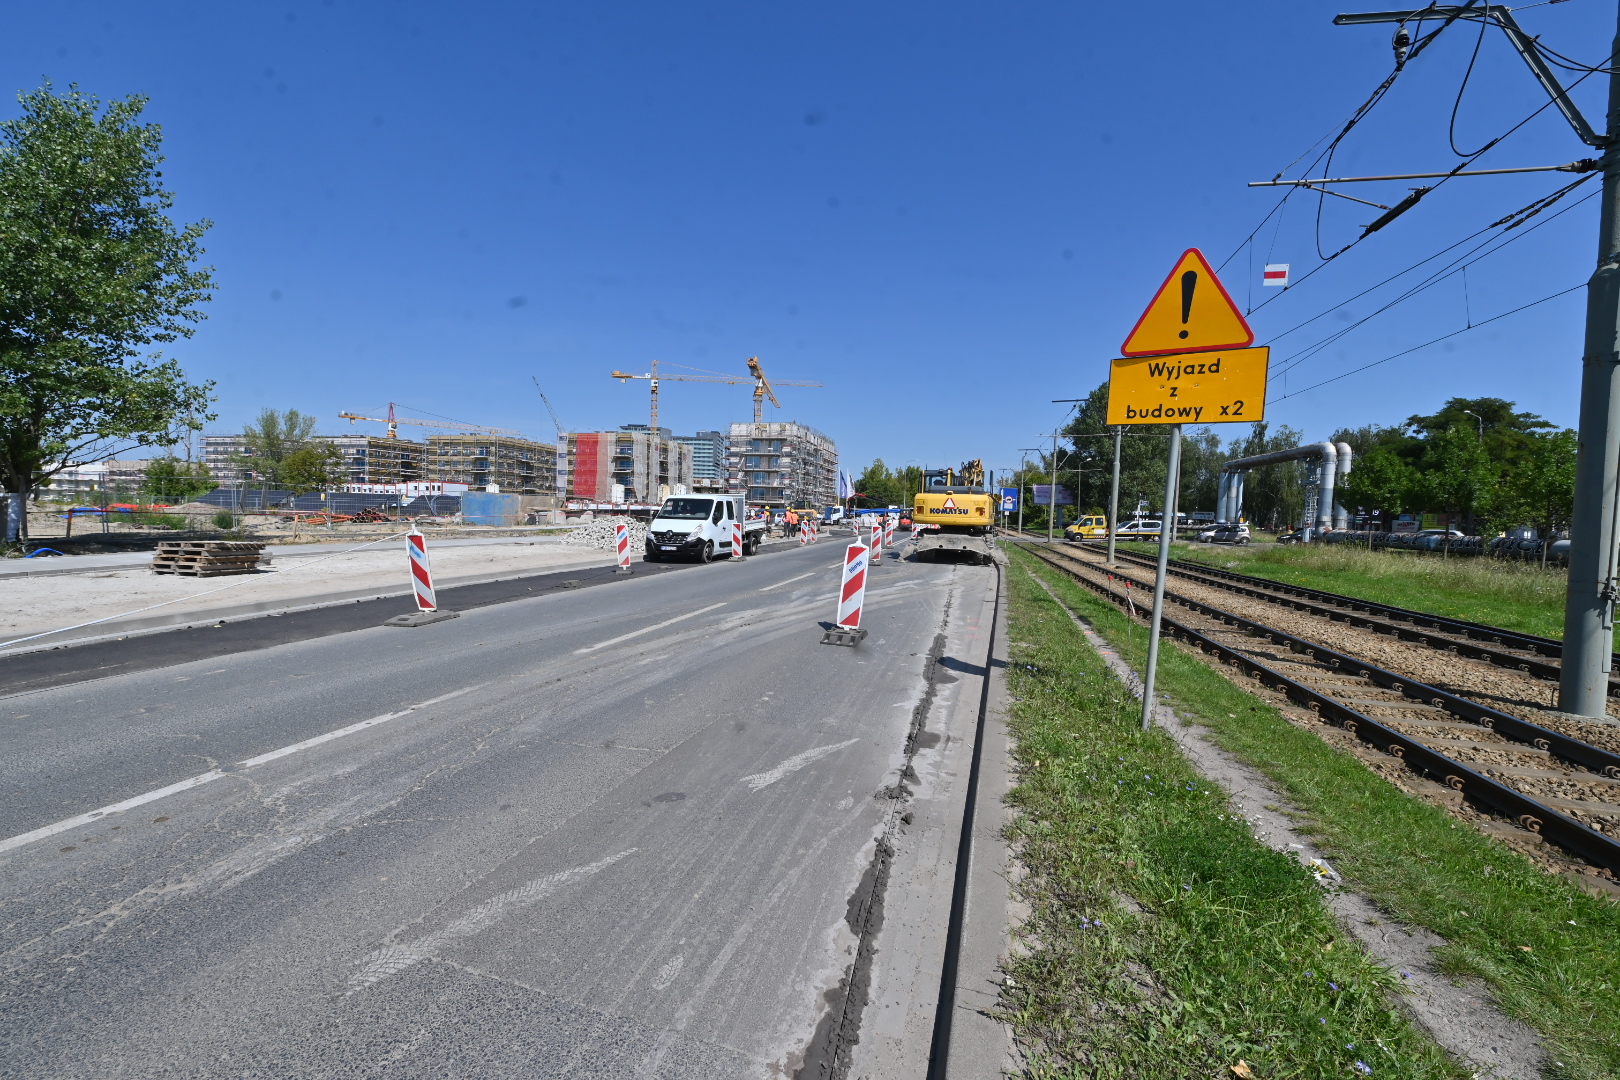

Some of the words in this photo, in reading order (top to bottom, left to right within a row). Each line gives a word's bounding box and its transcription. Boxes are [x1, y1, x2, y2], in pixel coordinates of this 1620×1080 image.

[1148, 358, 1221, 381] Wyjazd
[1169, 387, 1178, 397] z
[1126, 404, 1203, 421] budowy
[1219, 400, 1245, 416] x2
[929, 507, 969, 515] KOMATSU
